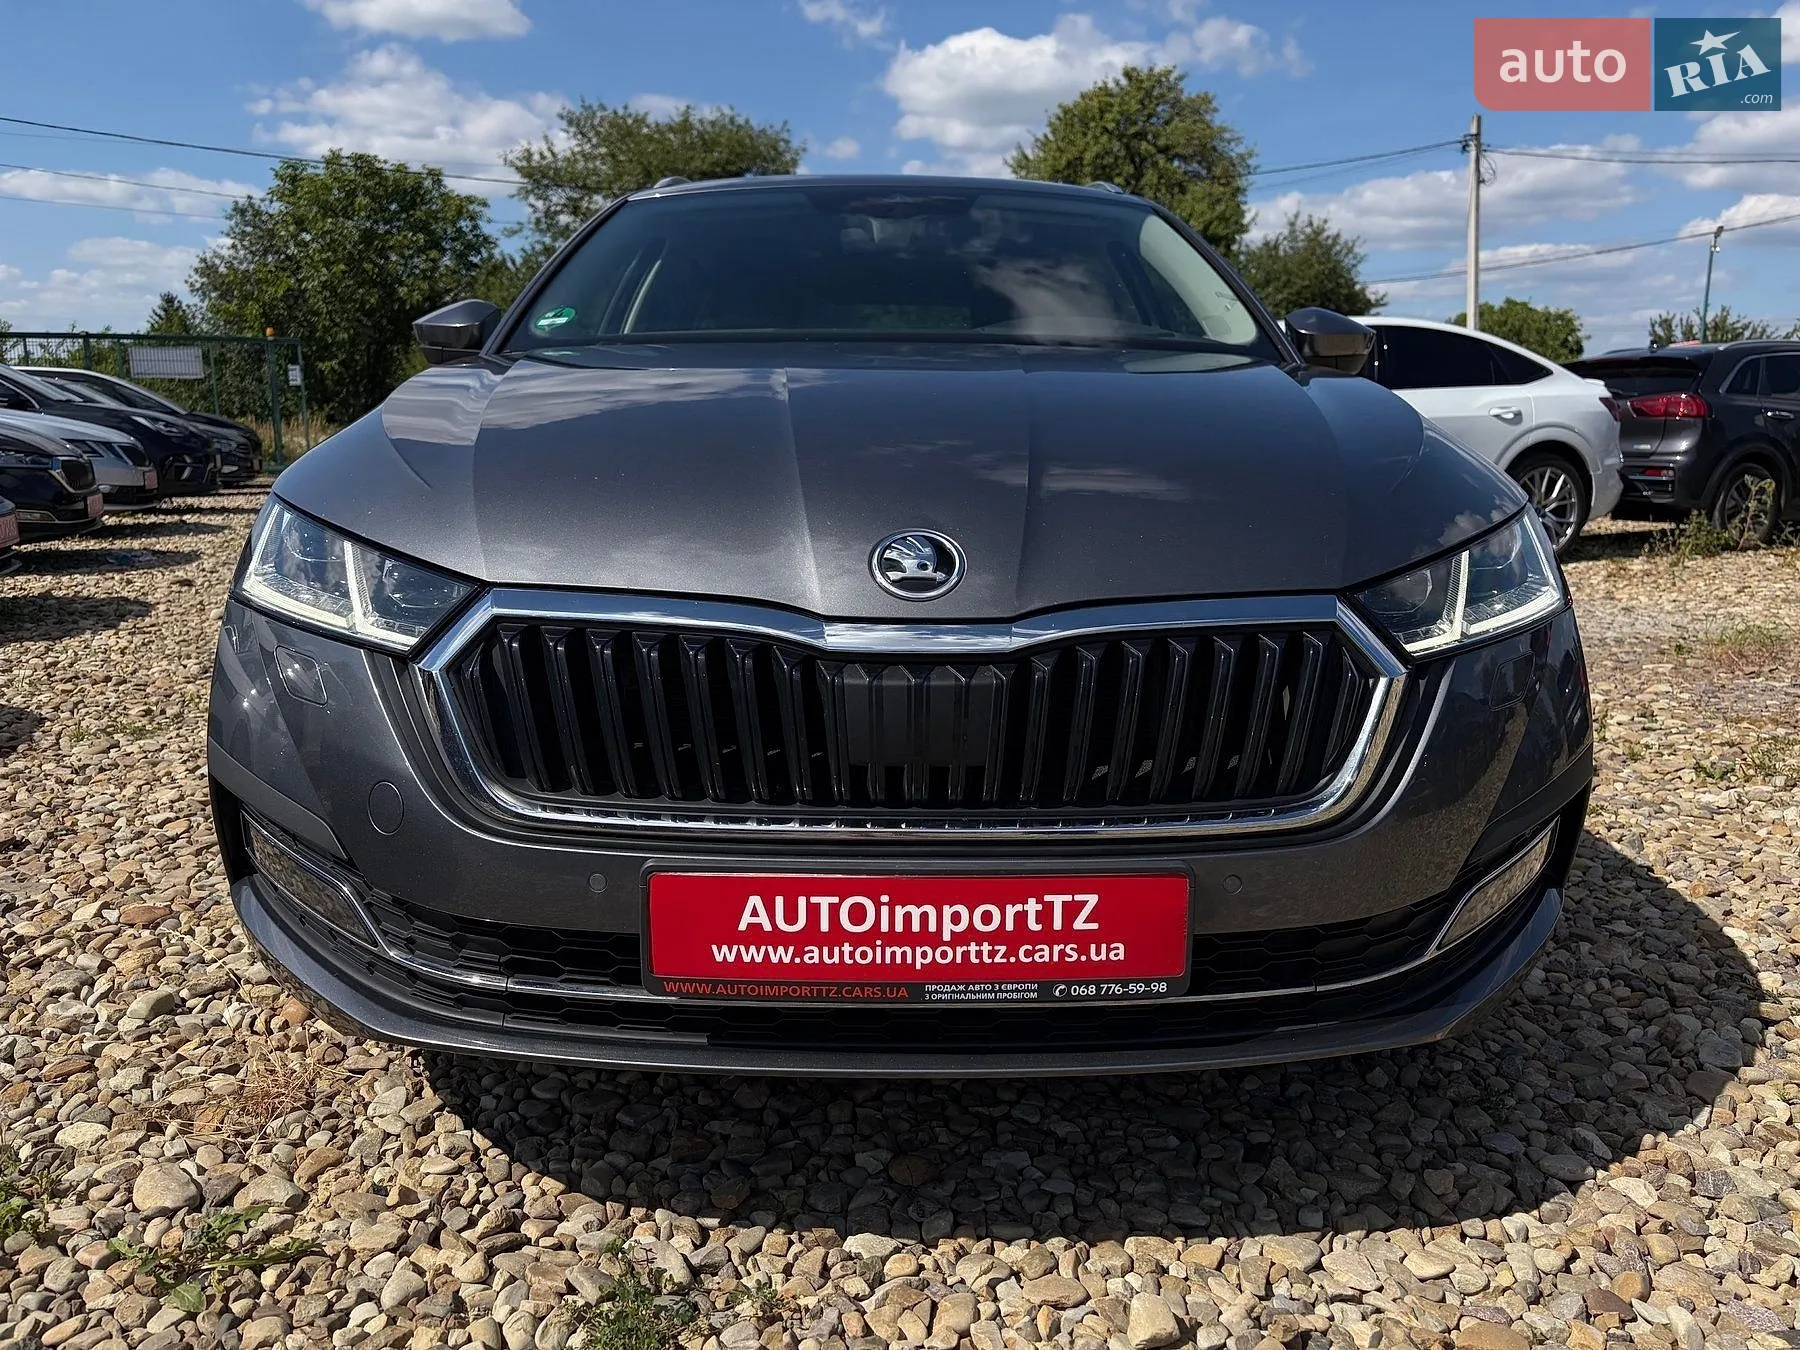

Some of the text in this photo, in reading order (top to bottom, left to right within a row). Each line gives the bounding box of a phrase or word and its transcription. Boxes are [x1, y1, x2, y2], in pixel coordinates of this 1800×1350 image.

[737, 894, 1099, 941] AUTOimportTZ
[711, 940, 1125, 970] www.autoimporttz.cars.ua
[663, 981, 908, 998] WWW.AUTOIMPORTTZ.CARS.UA
[925, 984, 966, 992] ПРОДАЖ
[1001, 983, 1038, 991] ЄВРОПИ
[1071, 982, 1167, 996] 068 776-59-98
[931, 992, 995, 1000] ОРИГІНАЛЬНИМ
